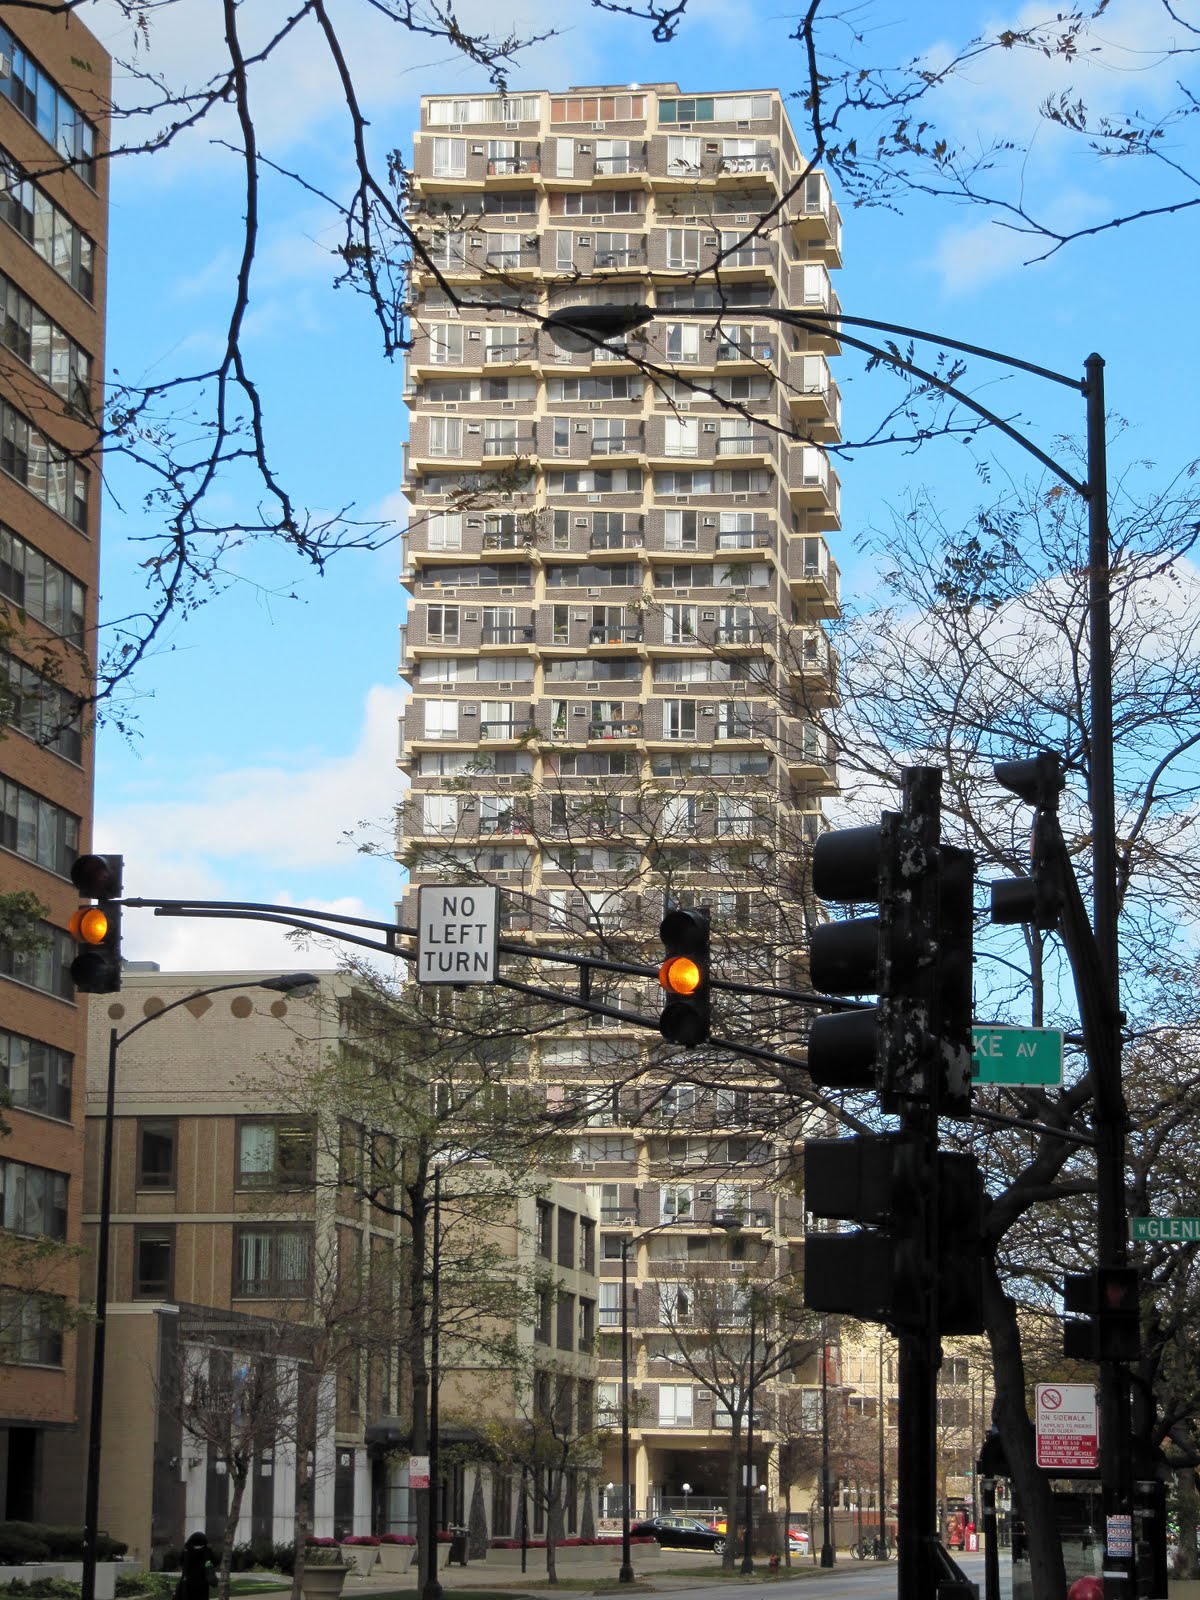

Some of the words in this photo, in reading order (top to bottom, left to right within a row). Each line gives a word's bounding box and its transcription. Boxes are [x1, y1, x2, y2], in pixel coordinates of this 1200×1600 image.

[443, 896, 475, 917] NO
[429, 924, 487, 944] LEFT
[424, 951, 488, 972] TURN
[1016, 1042, 1037, 1057] AV
[1138, 1224, 1146, 1234] W
